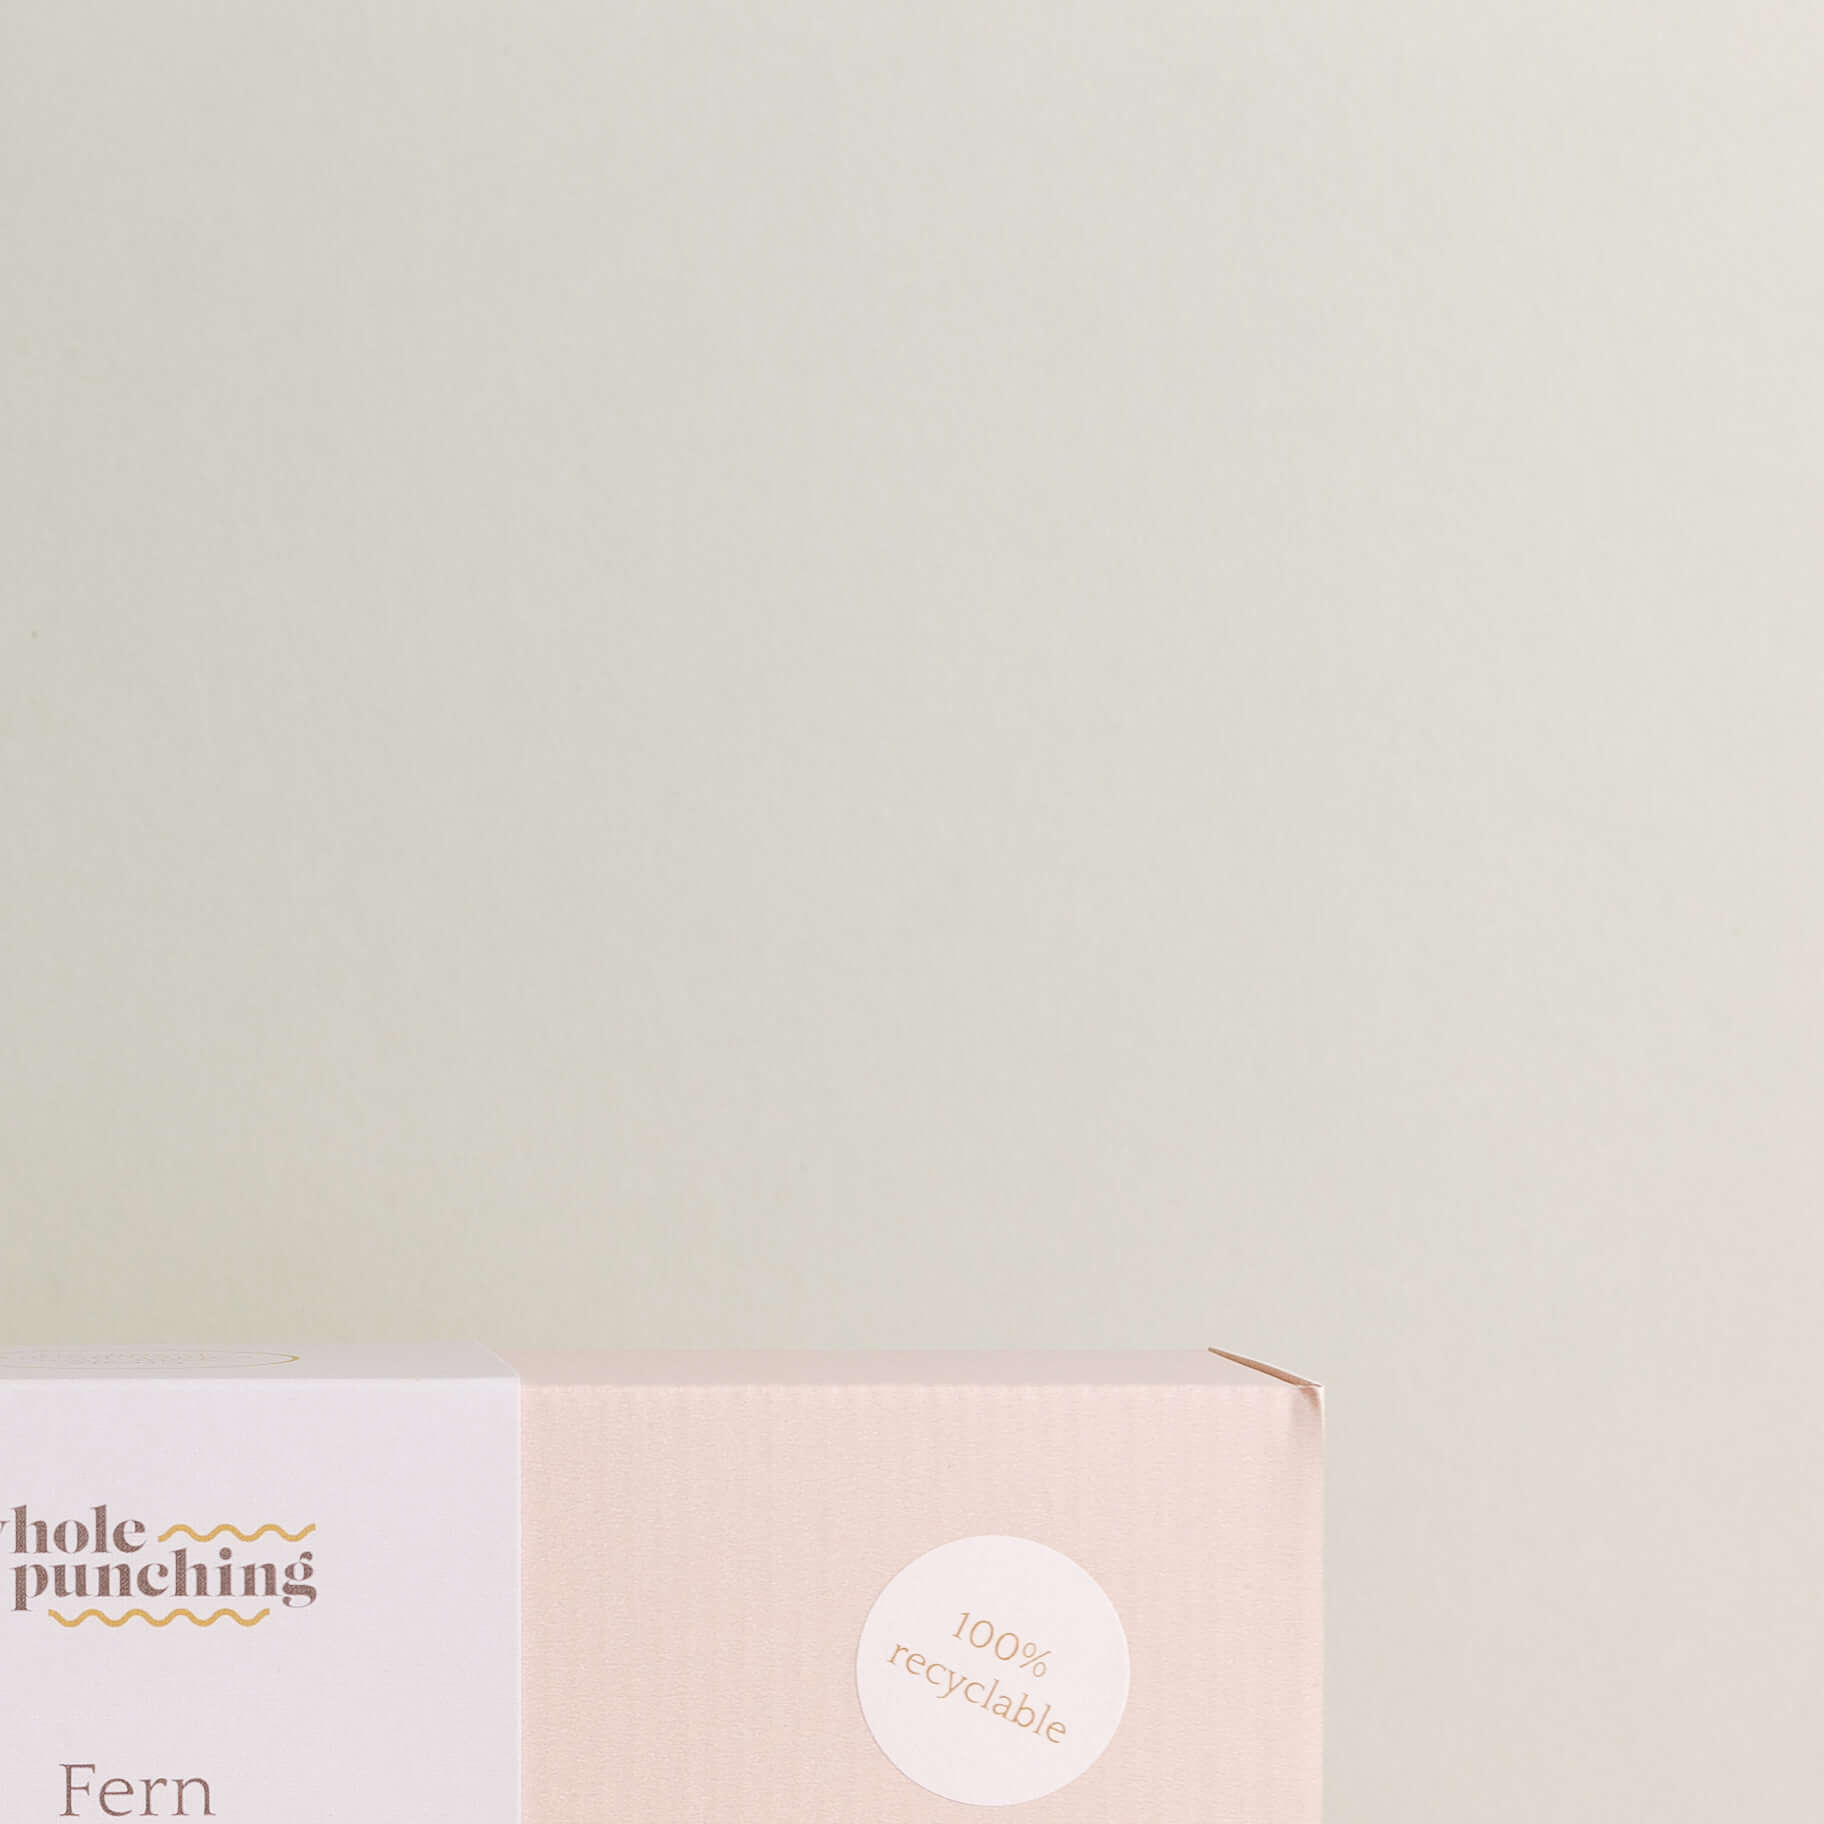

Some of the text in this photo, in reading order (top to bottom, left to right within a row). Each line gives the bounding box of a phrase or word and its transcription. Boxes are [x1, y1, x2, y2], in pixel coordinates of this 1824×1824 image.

[11, 1547, 317, 1611] punching
[951, 1612, 1052, 1678] 100%
[888, 1642, 1067, 1744] recyclable
[59, 1764, 216, 1818] Fern
